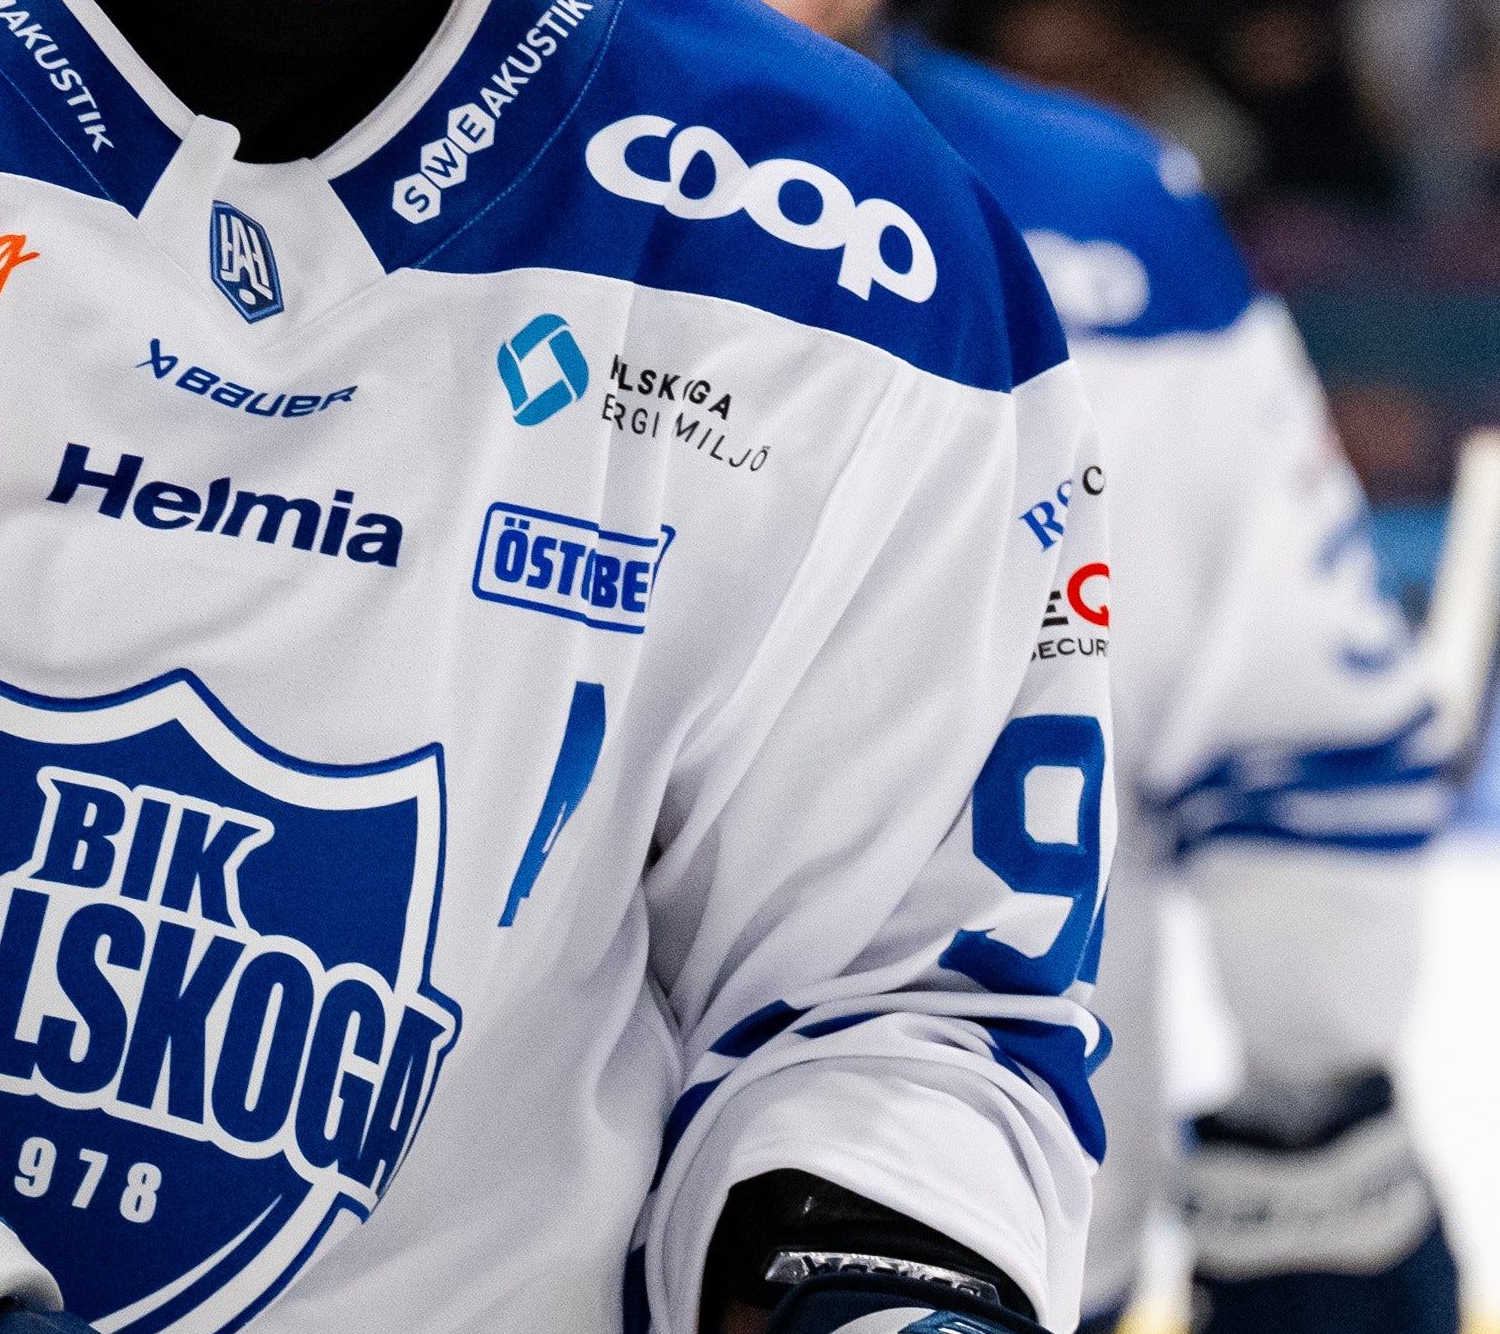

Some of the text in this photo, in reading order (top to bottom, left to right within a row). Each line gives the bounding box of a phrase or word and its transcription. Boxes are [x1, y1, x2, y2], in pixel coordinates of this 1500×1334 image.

[584, 114, 937, 303] coop
[175, 366, 357, 418] BAUER
[46, 443, 403, 566] Helmia
[30, 779, 268, 929] BIK
[939, 715, 1107, 995] 9
